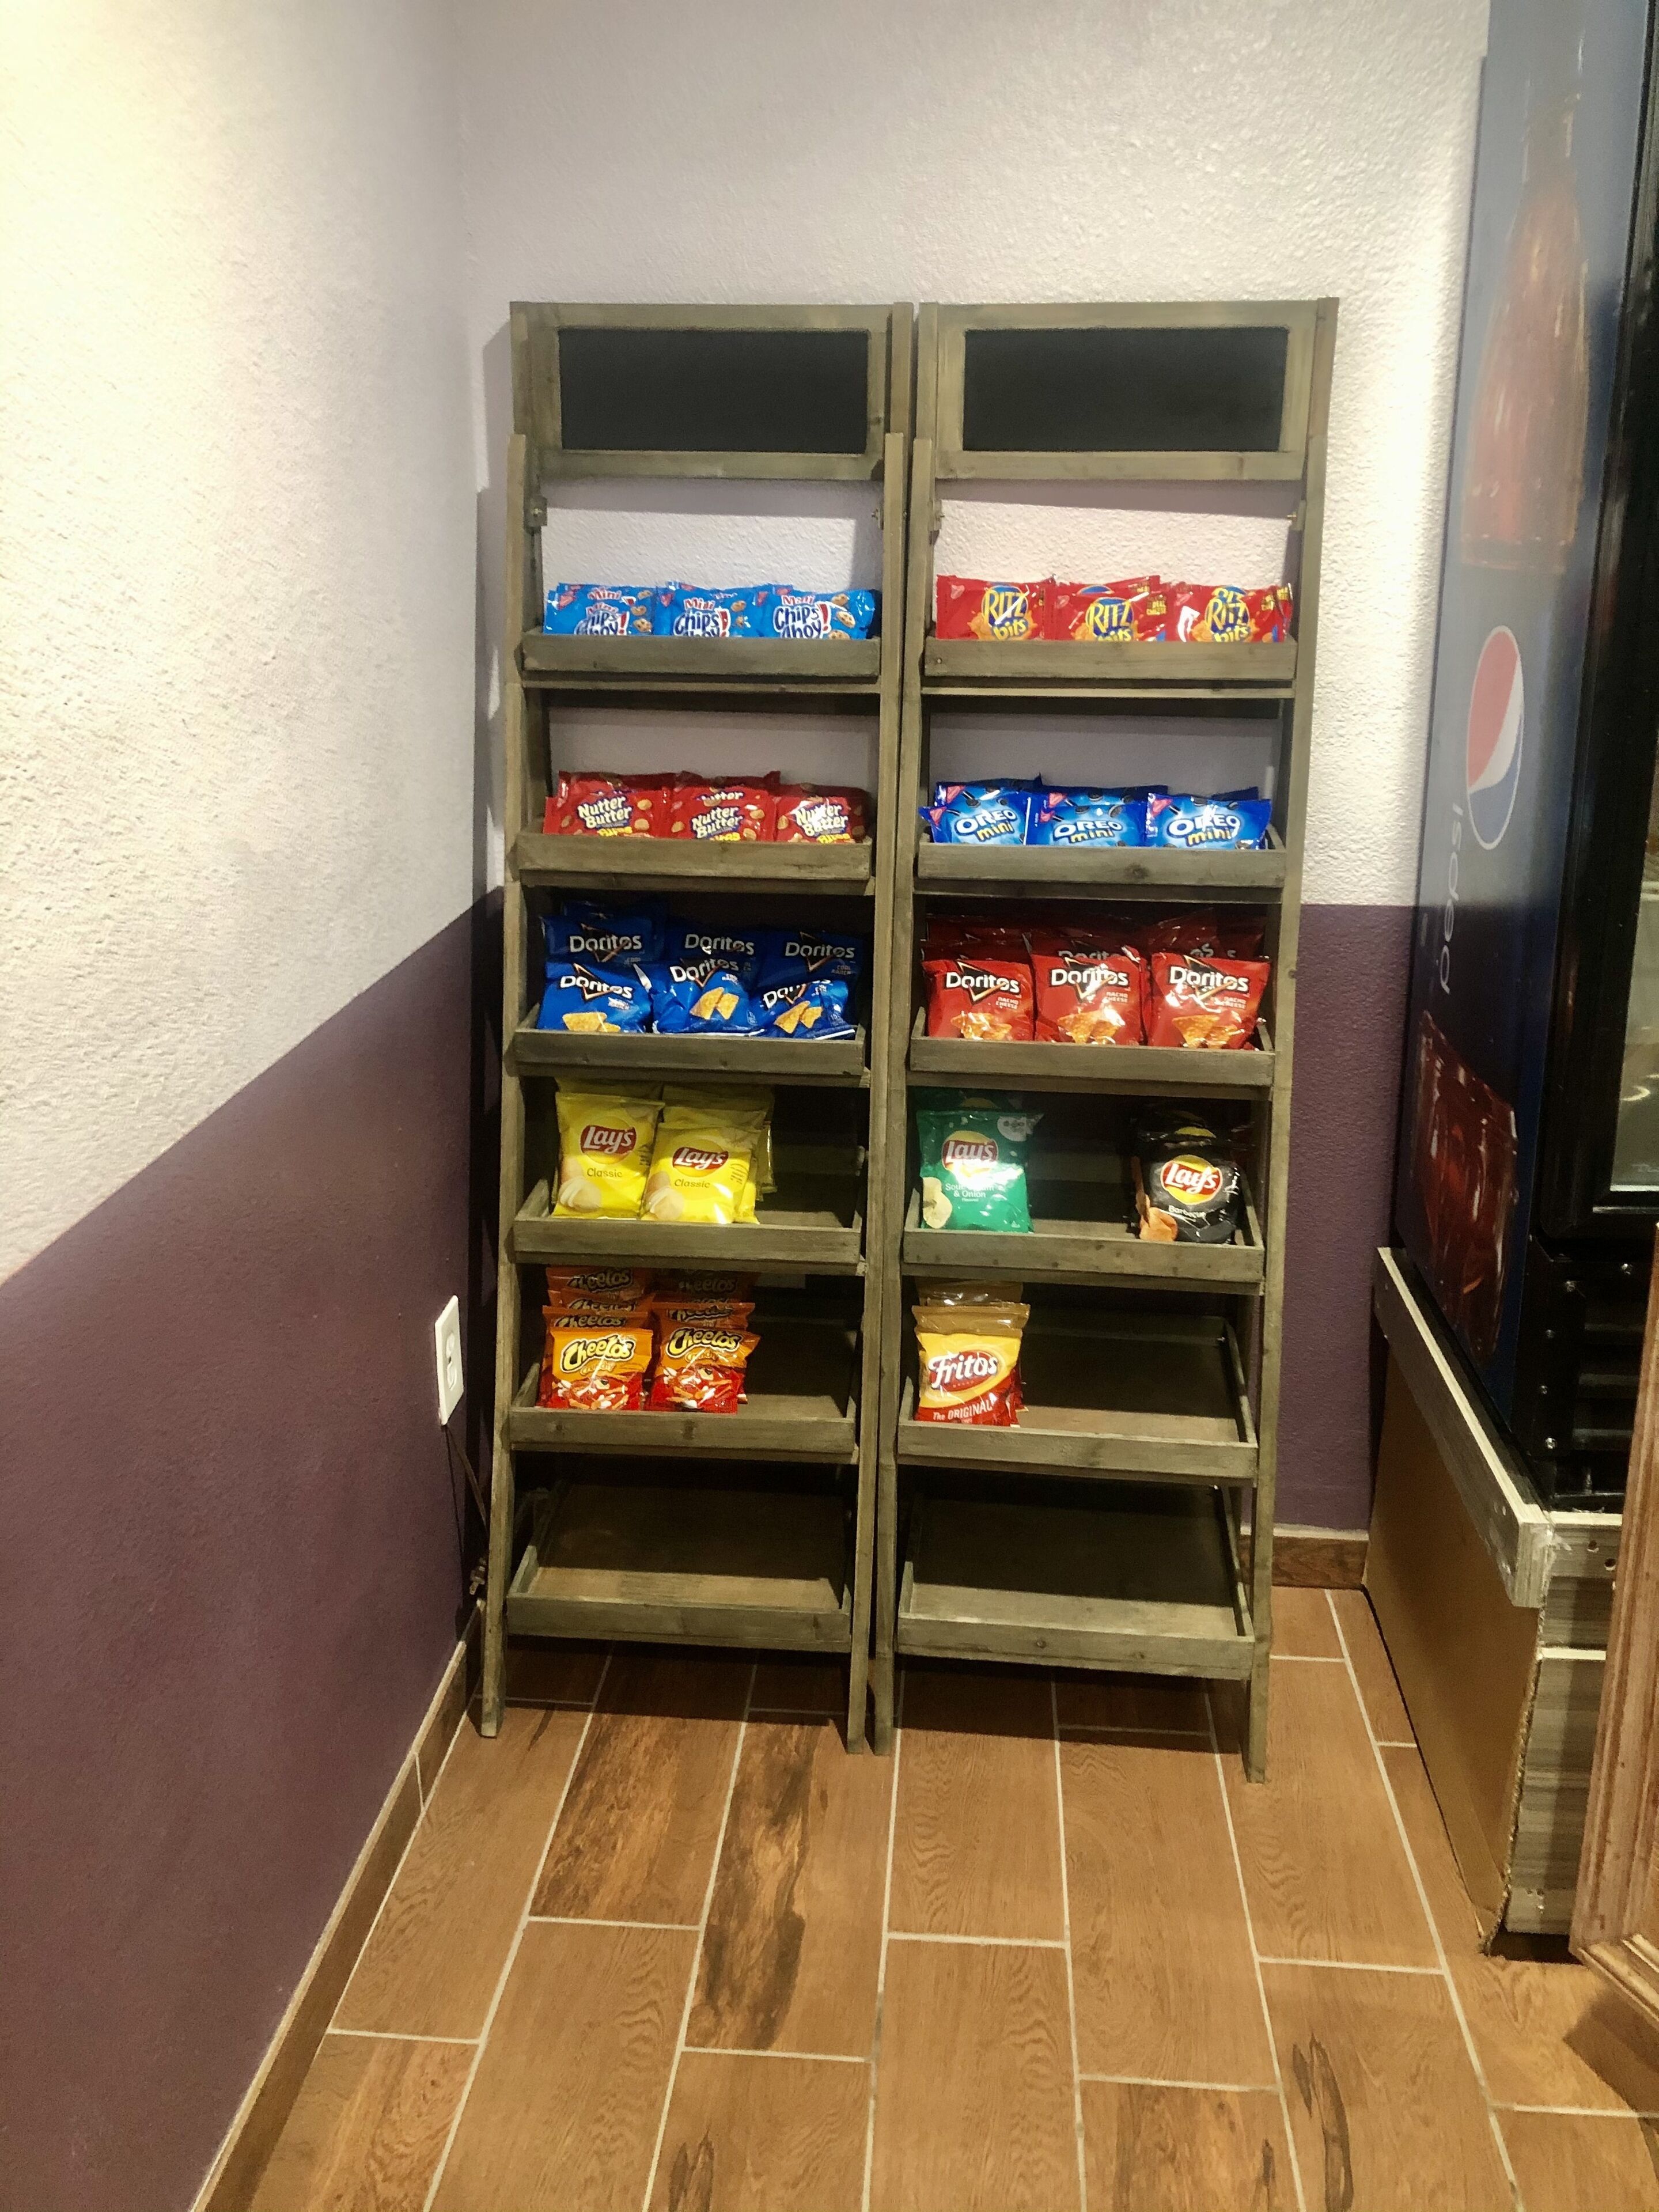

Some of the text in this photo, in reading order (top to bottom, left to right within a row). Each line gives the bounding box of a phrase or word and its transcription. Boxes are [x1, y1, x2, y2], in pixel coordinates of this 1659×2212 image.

[983, 589, 1026, 625] RITZ
[1088, 601, 1131, 634] RITZ
[675, 612, 719, 634] Chips
[774, 607, 819, 630] Chips
[993, 620, 1027, 640] bits
[577, 797, 626, 818] Nutter
[586, 807, 632, 829] Butter
[796, 805, 842, 826] Nutter
[692, 807, 739, 831] Nutter
[696, 816, 744, 839] Butter
[804, 816, 849, 836] Butter
[956, 809, 1017, 834] OREO
[1054, 821, 1122, 838] OREO
[1168, 815, 1240, 836] OREO
[977, 821, 1013, 840] mini
[1070, 830, 1113, 842] mini
[1187, 828, 1232, 845] mini
[1440, 802, 1464, 995] pepsi
[569, 935, 643, 953] Doritos
[684, 933, 755, 956] Doritos
[785, 941, 856, 959] Doritos
[669, 958, 739, 982] Doritos
[1051, 968, 1129, 986] Doritos
[1169, 966, 1249, 992] Doritos
[560, 975, 634, 999] Doritos
[946, 972, 1020, 994] Doritos
[586, 1167, 623, 1178] Classic
[1165, 1163, 1219, 1194] Lay's
[674, 1179, 711, 1189] Classic
[953, 1190, 986, 1198] & Onion
[562, 1335, 633, 1371] Cheetos
[669, 1329, 737, 1357] Cheetos
[929, 1354, 998, 1389] Fritos
[933, 1412, 946, 1421] The
[948, 1399, 993, 1420] ORIGINAL
